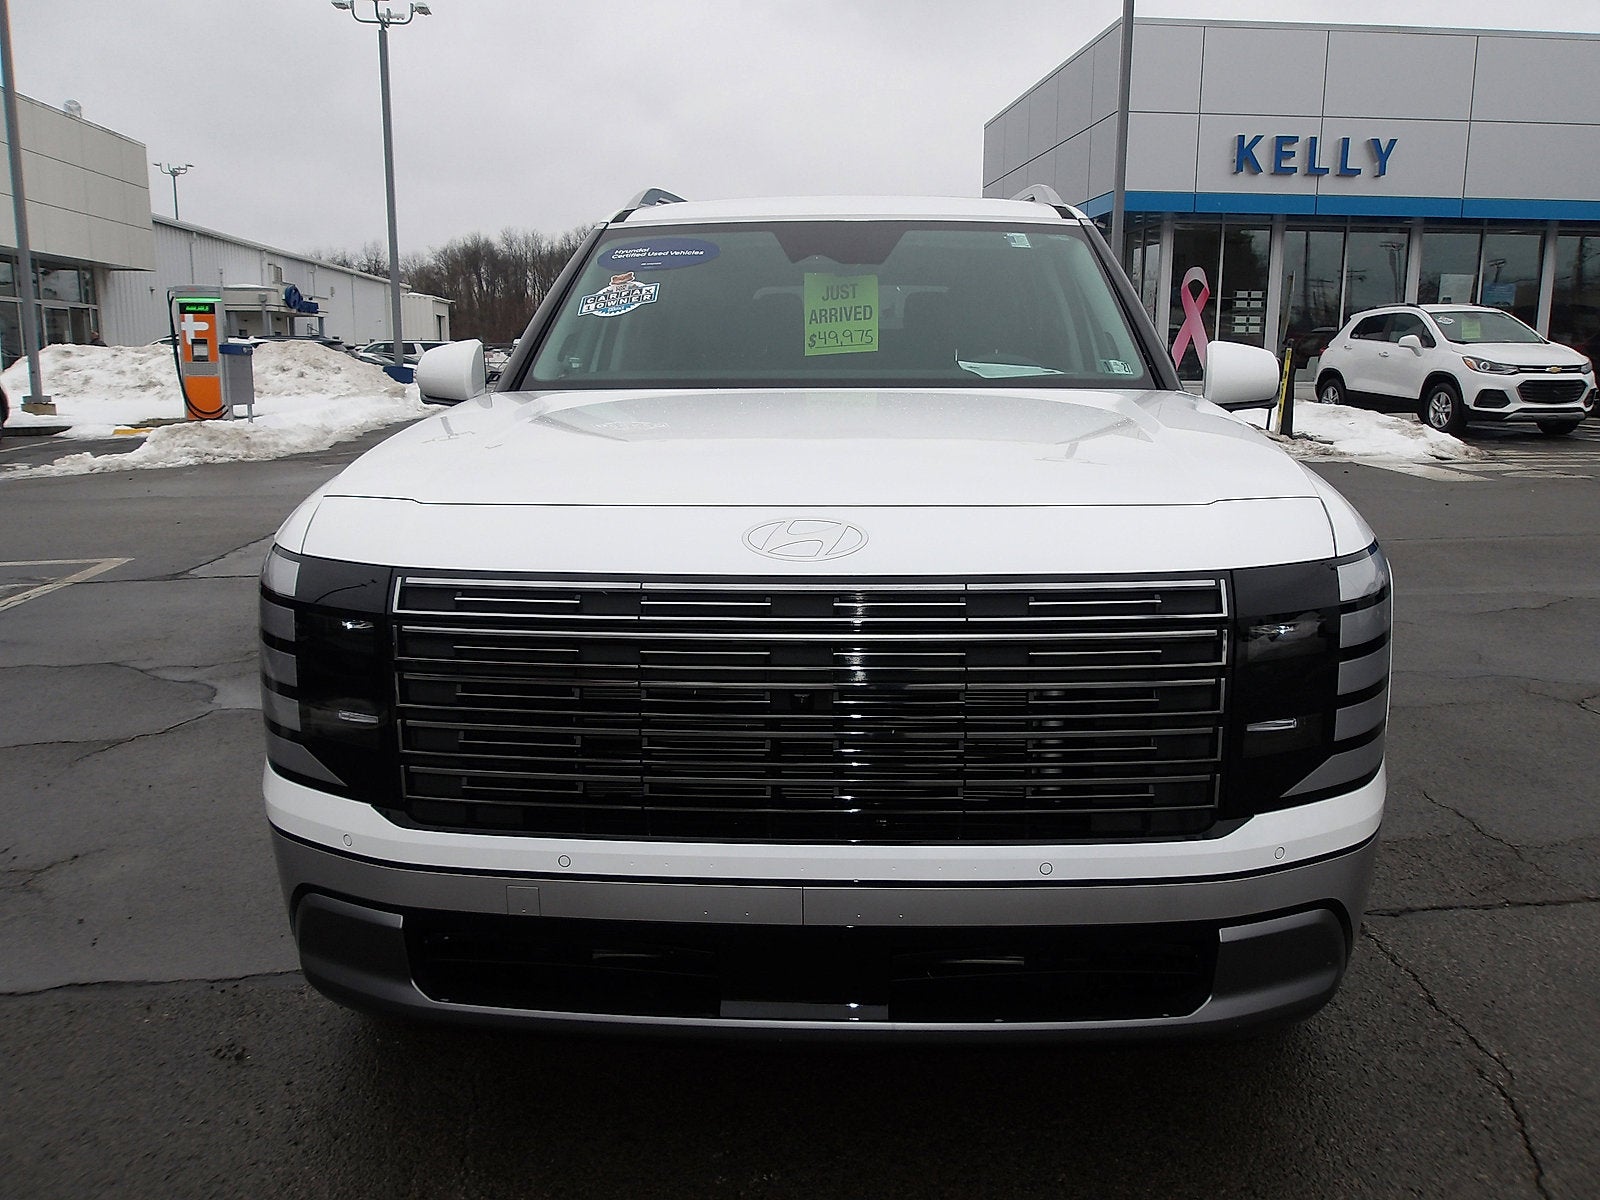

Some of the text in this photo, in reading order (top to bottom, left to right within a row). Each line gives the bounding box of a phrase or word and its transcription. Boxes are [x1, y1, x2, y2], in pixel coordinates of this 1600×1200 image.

[1234, 134, 1398, 177] KELLY
[611, 252, 647, 260] Certified
[614, 247, 650, 255] Hyundai
[586, 288, 653, 304] CARFAX
[822, 283, 858, 301] JUST
[596, 294, 652, 309] OWNER
[809, 305, 873, 324] ARRIVED
[808, 329, 873, 349] $49,975
